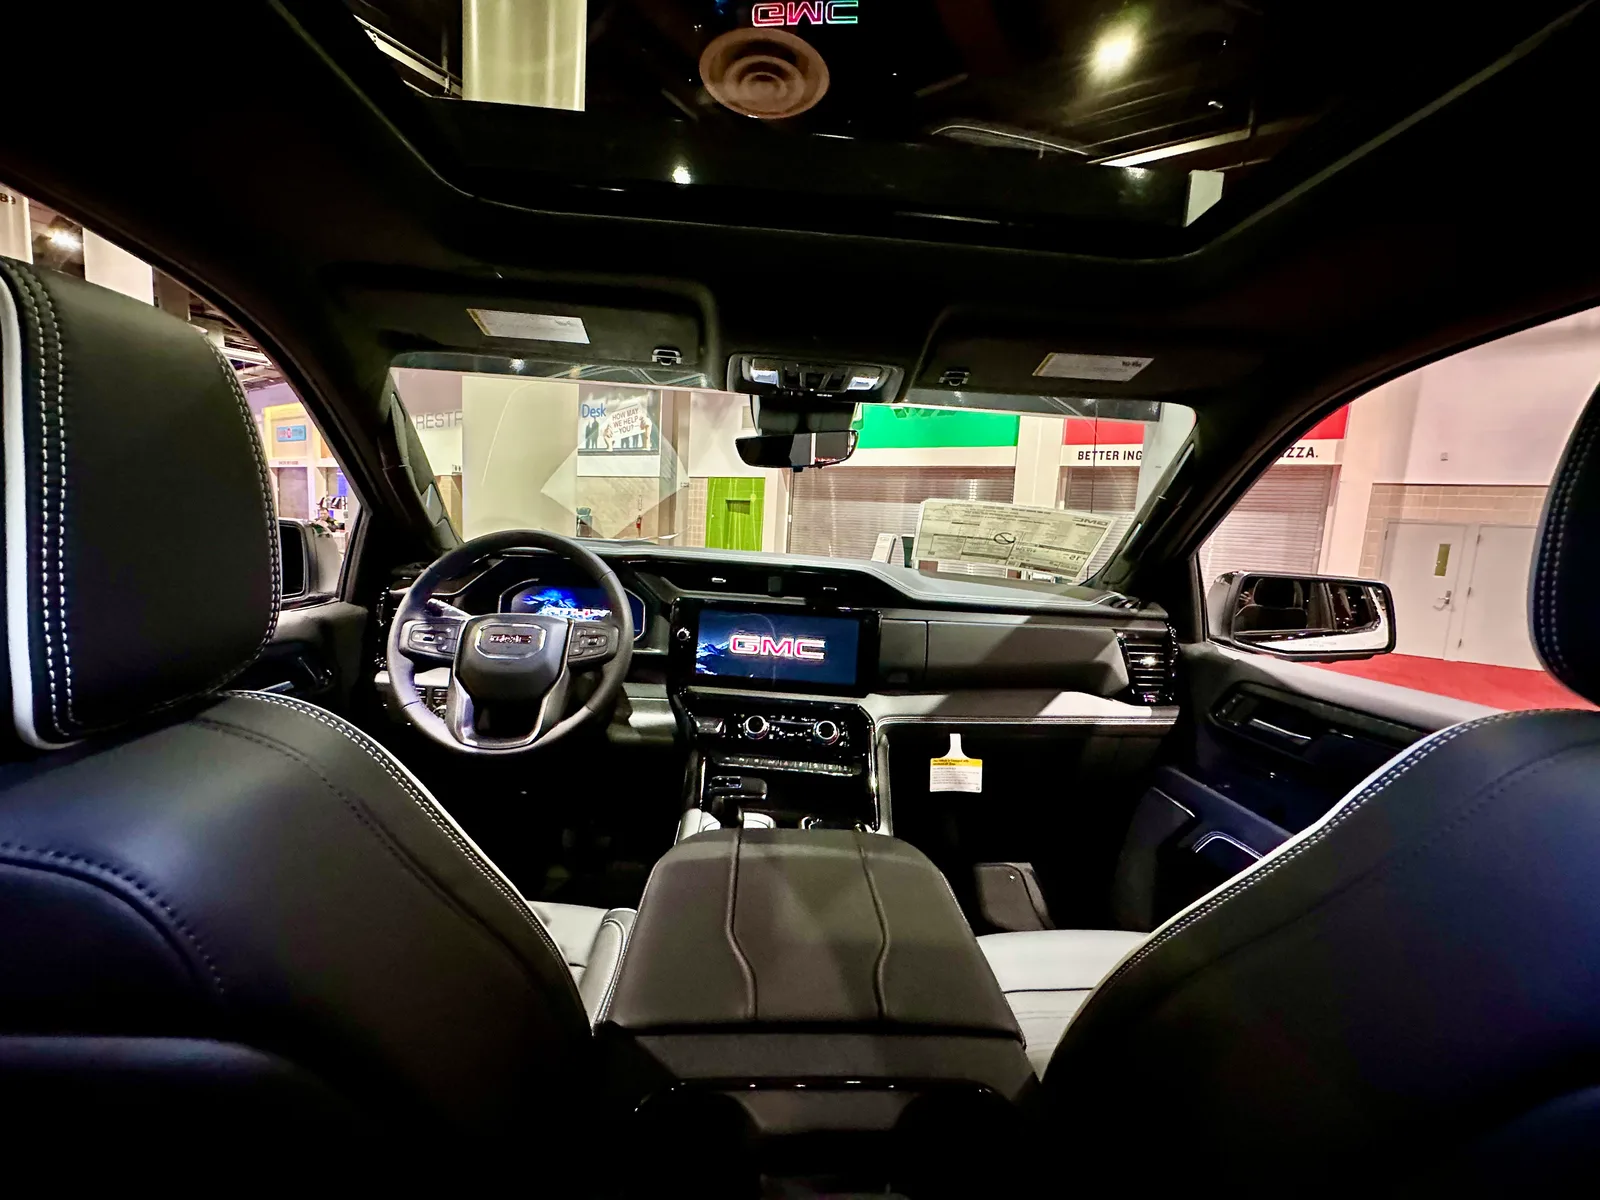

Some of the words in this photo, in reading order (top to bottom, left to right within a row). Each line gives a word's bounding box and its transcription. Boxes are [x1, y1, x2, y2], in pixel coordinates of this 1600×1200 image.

[582, 403, 606, 418] Desk
[612, 412, 626, 421] HOW
[627, 408, 638, 417] MAY
[613, 420, 622, 428] WE
[623, 416, 638, 425] HELP
[619, 425, 634, 434] YOU?
[1077, 450, 1119, 460] BETTER
[729, 635, 825, 660] GMC
